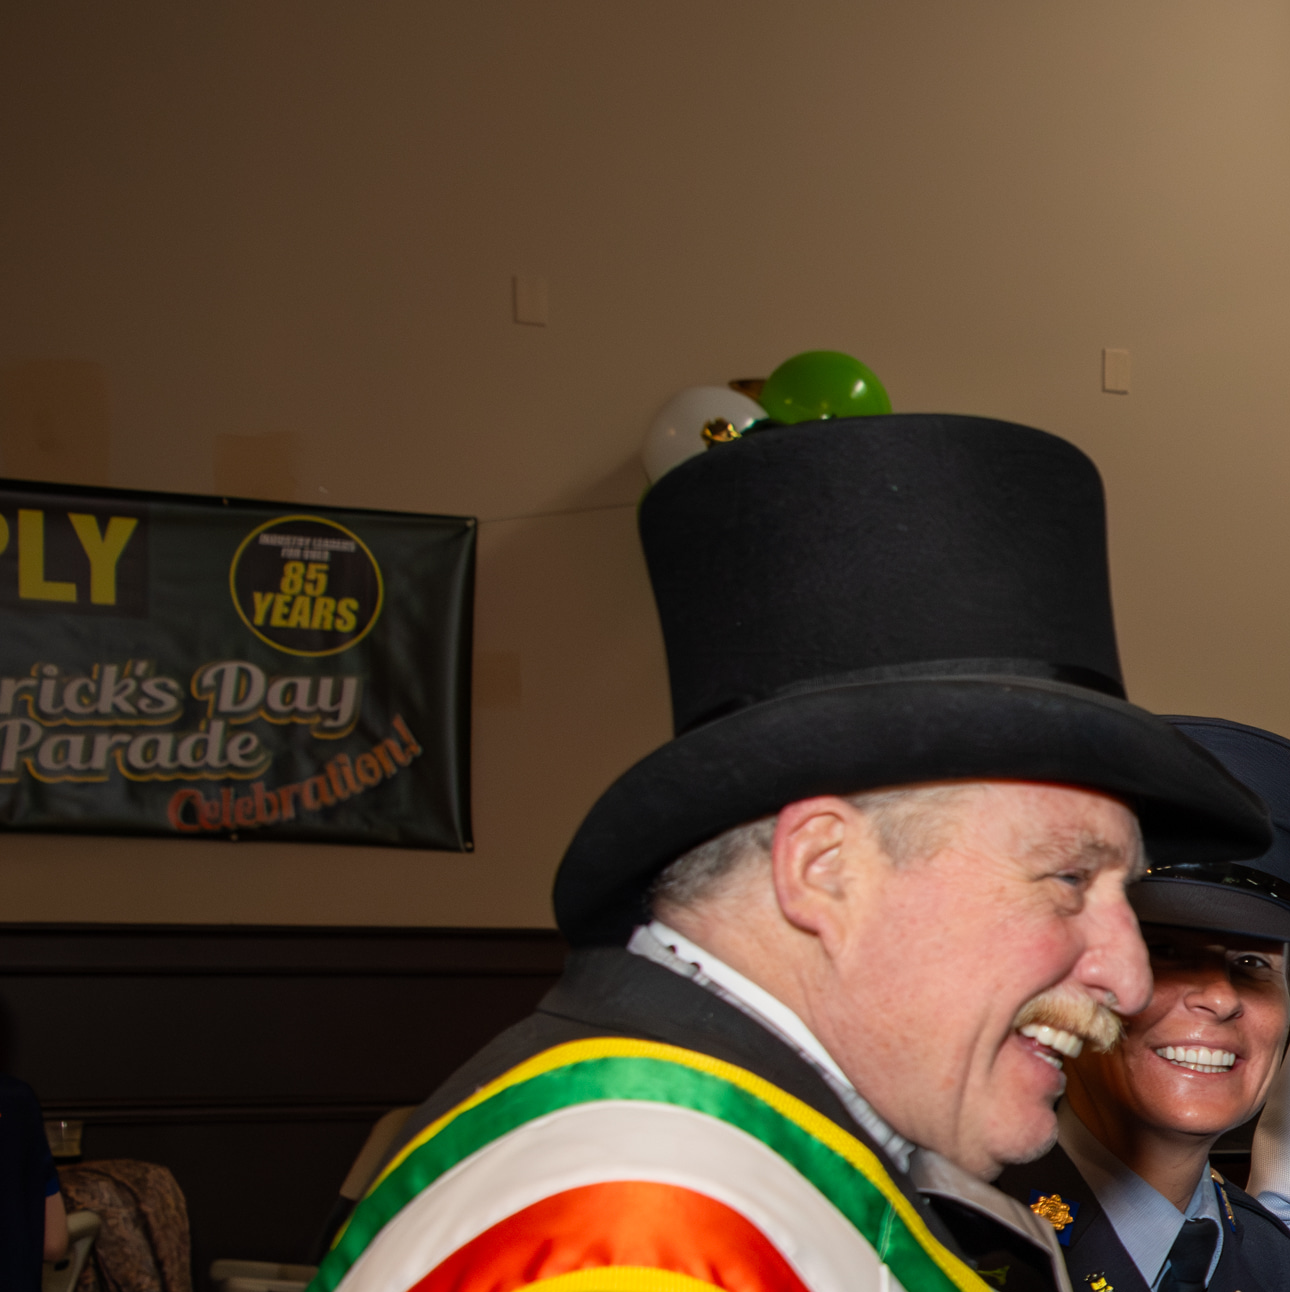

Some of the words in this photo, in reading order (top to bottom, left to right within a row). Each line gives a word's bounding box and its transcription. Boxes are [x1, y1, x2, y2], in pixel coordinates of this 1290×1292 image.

[0, 508, 139, 606] LY
[279, 560, 330, 597] 85
[252, 591, 360, 633] YEARS
[192, 660, 360, 738] Day
[0, 718, 270, 780] Parade
[167, 714, 422, 833] Celebration!
